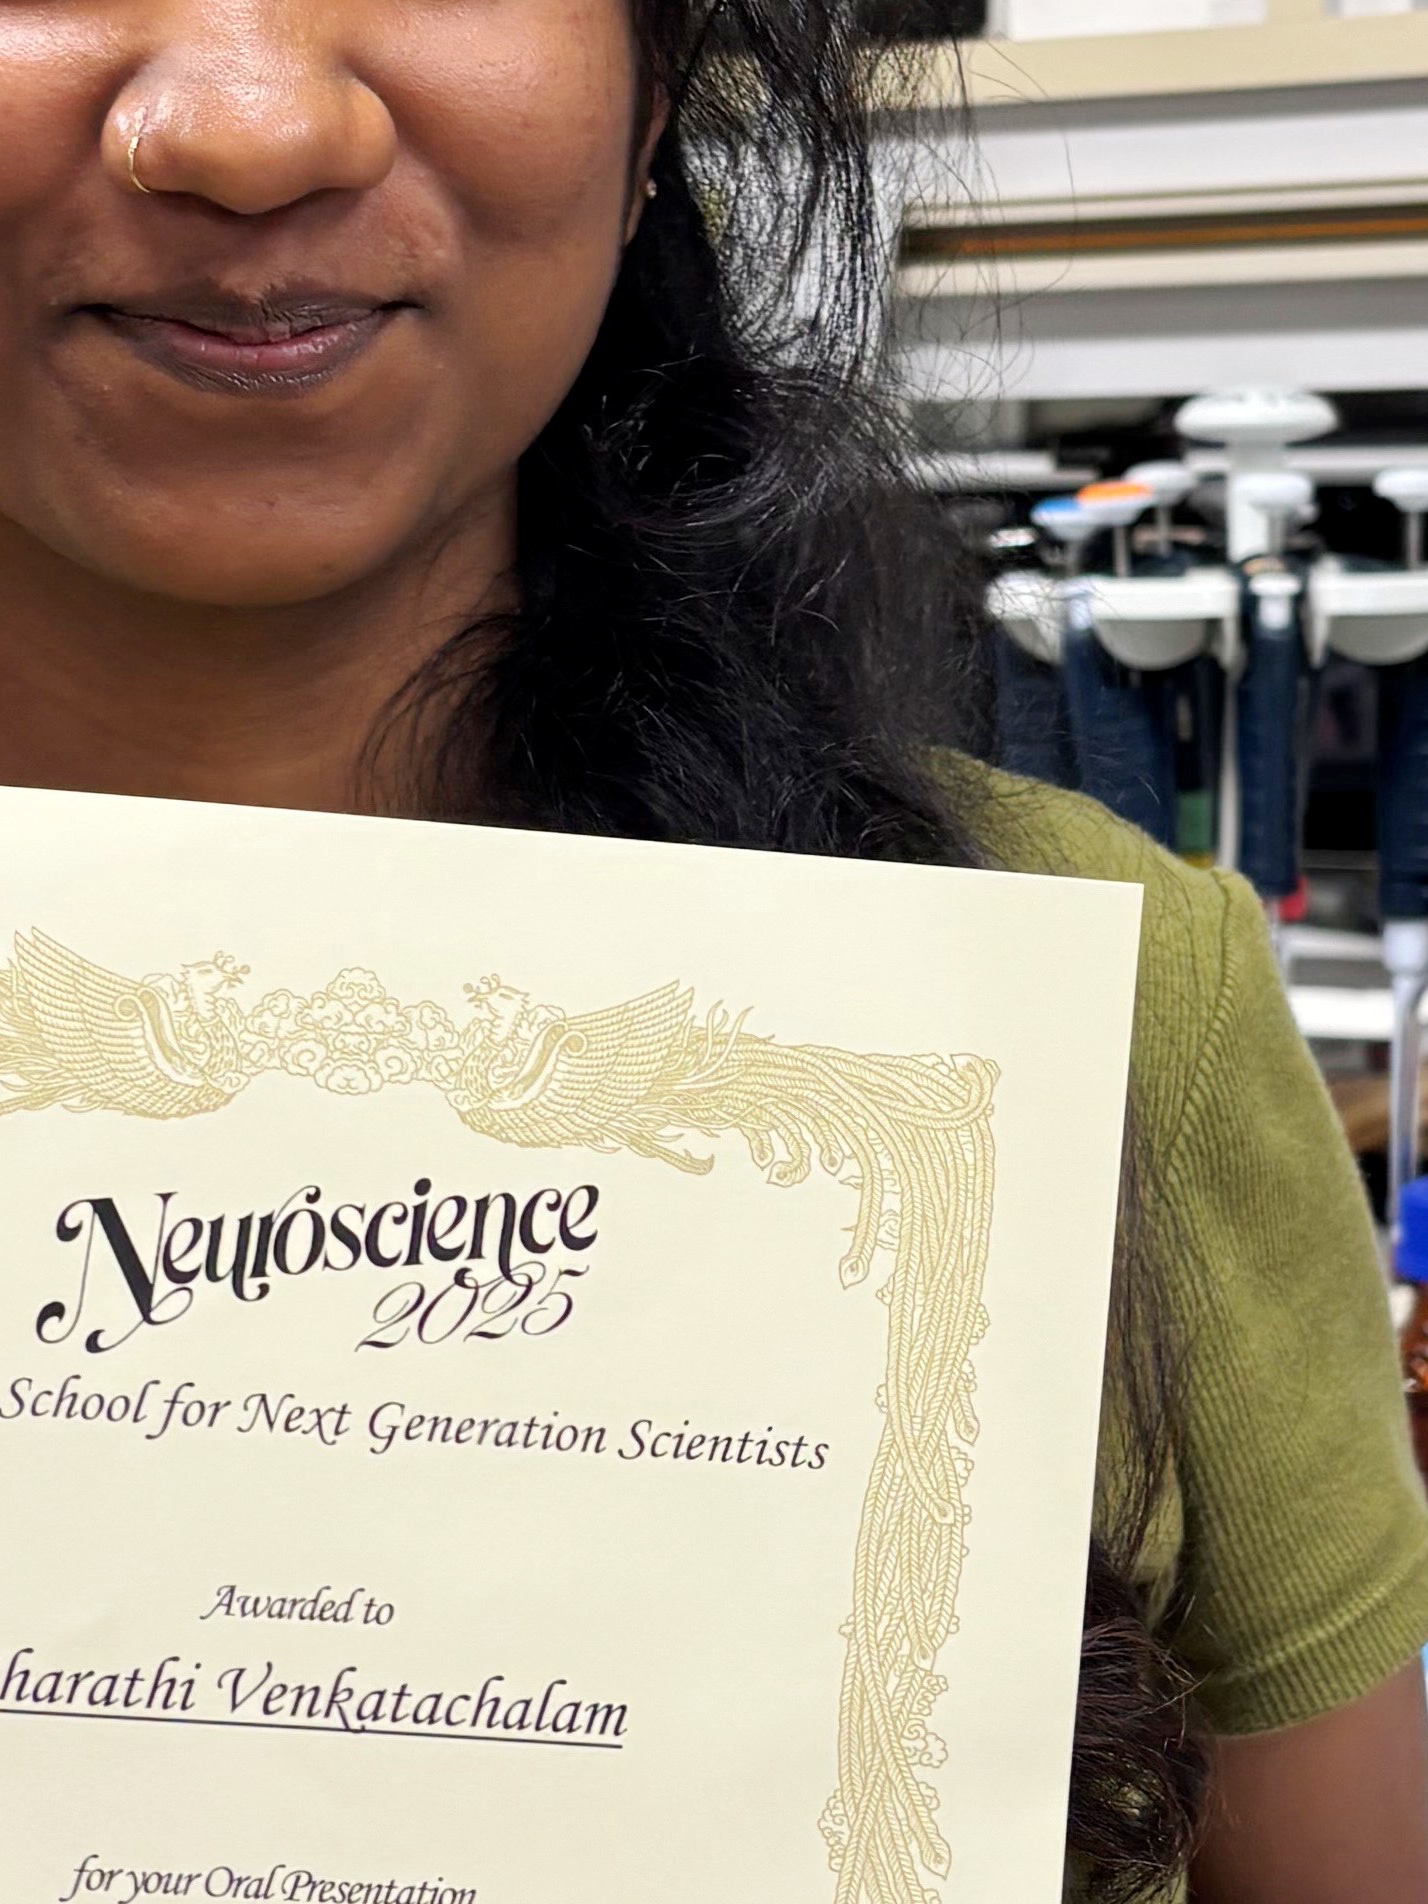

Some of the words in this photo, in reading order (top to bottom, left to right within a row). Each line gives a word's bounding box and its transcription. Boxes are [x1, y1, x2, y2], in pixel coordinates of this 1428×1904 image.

[36, 1176, 600, 1354] Neuroscience
[355, 1262, 591, 1350] 2025
[145, 1382, 231, 1440] for
[237, 1393, 352, 1445] Next
[369, 1402, 606, 1454] Generation
[617, 1419, 829, 1469] Scientists
[199, 1585, 365, 1623] Awarded
[363, 1598, 394, 1625] to
[215, 1664, 628, 1737] Venkatachalam
[59, 1854, 123, 1902] for
[118, 1871, 202, 1904] your
[205, 1864, 286, 1899] Oral
